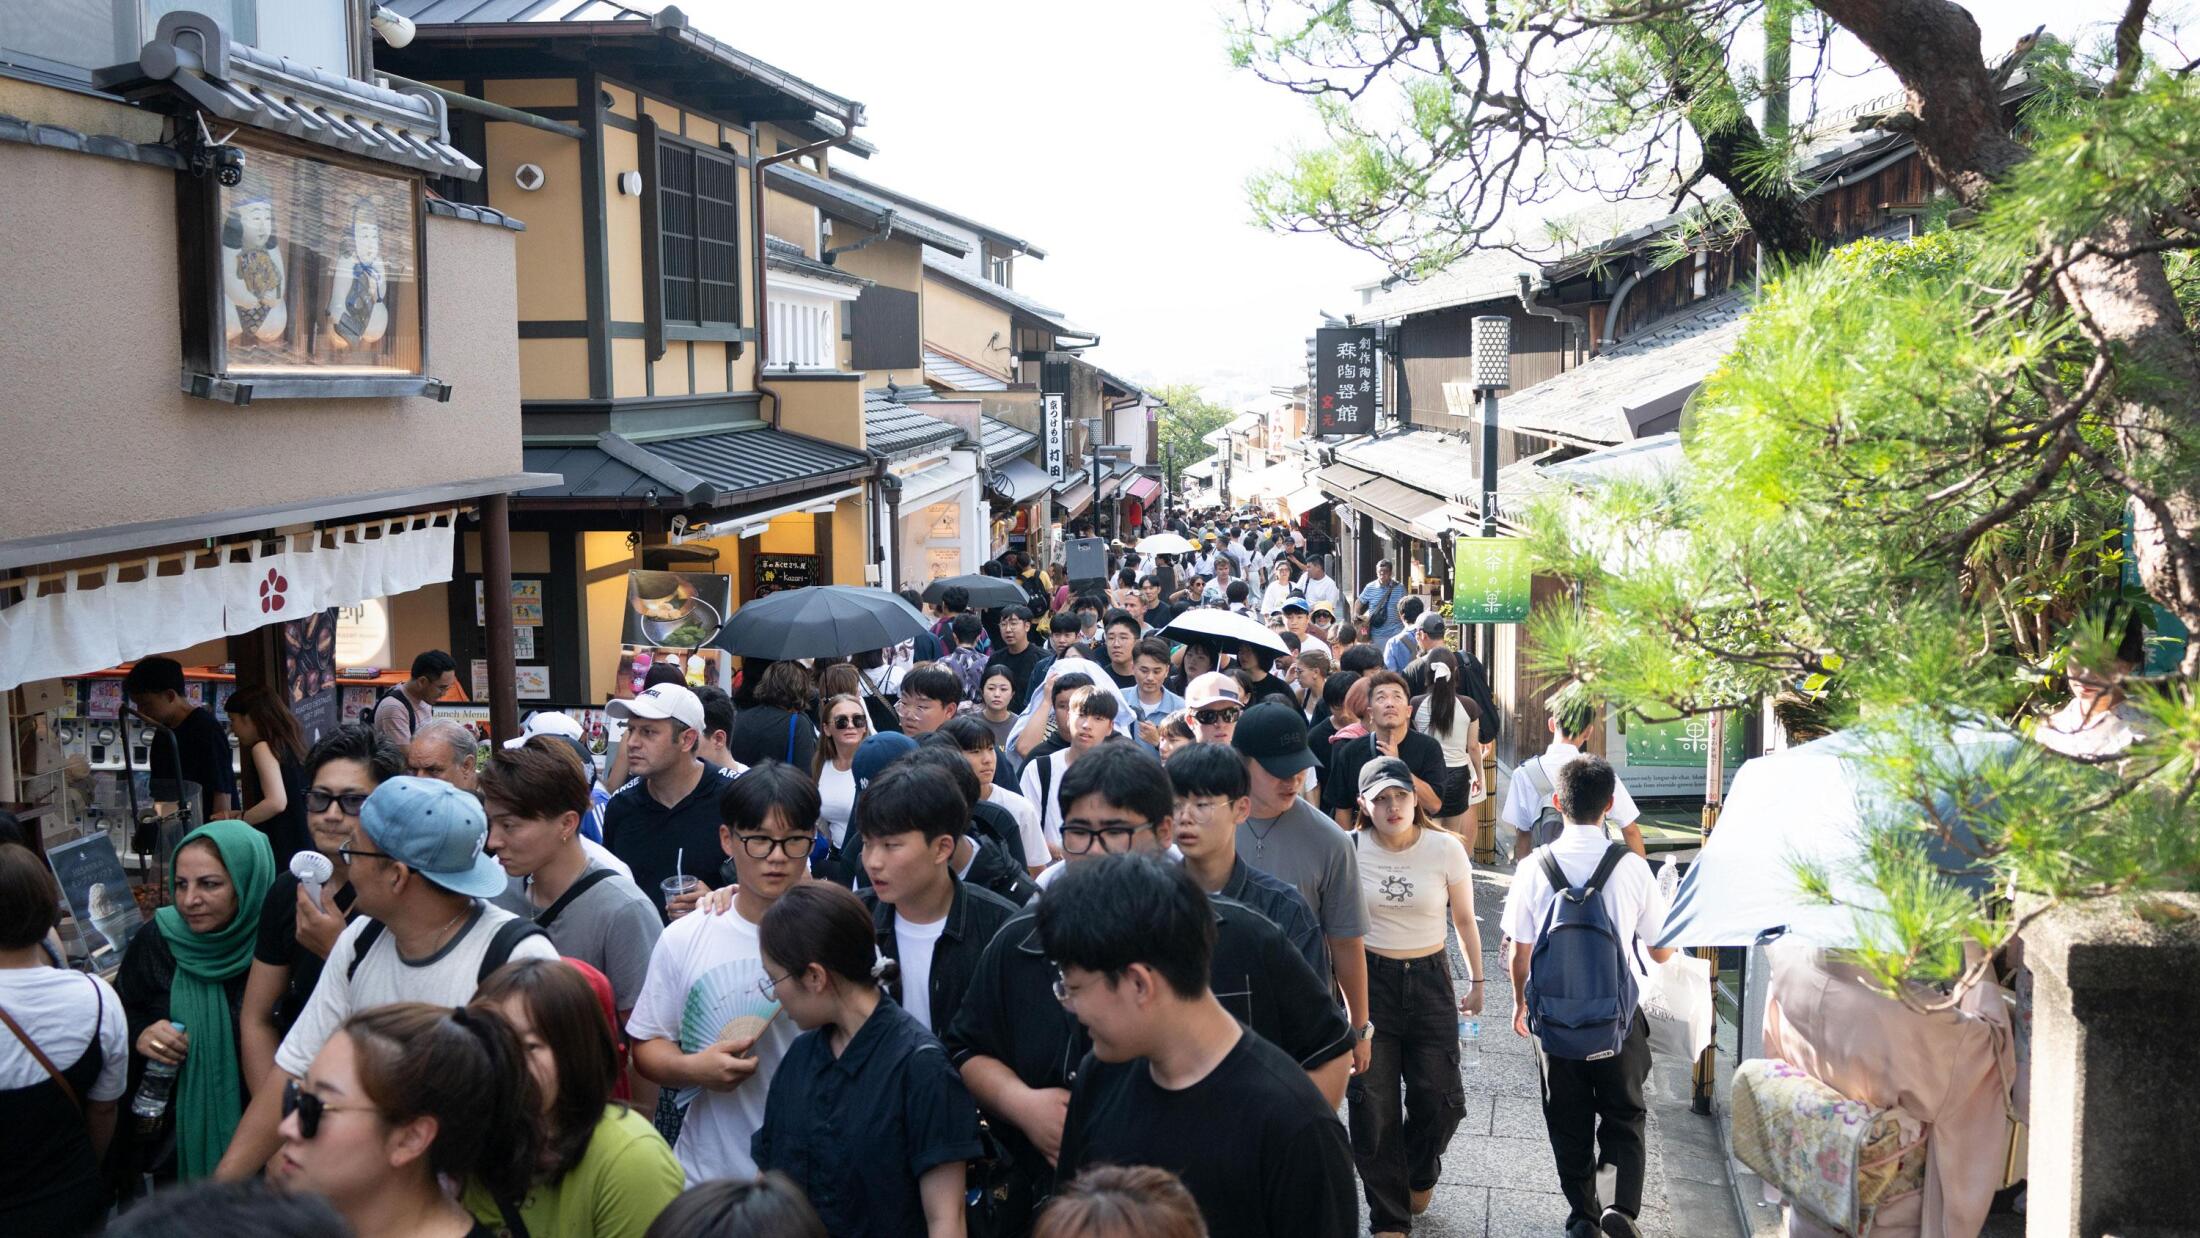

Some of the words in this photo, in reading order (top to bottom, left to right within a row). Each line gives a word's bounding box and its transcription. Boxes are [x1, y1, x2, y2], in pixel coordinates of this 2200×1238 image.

[1336, 342, 1358, 422] 森陶器館
[1359, 337, 1371, 393] 創作陶房
[433, 709, 460, 718] Lunch
[463, 709, 488, 719] Menu
